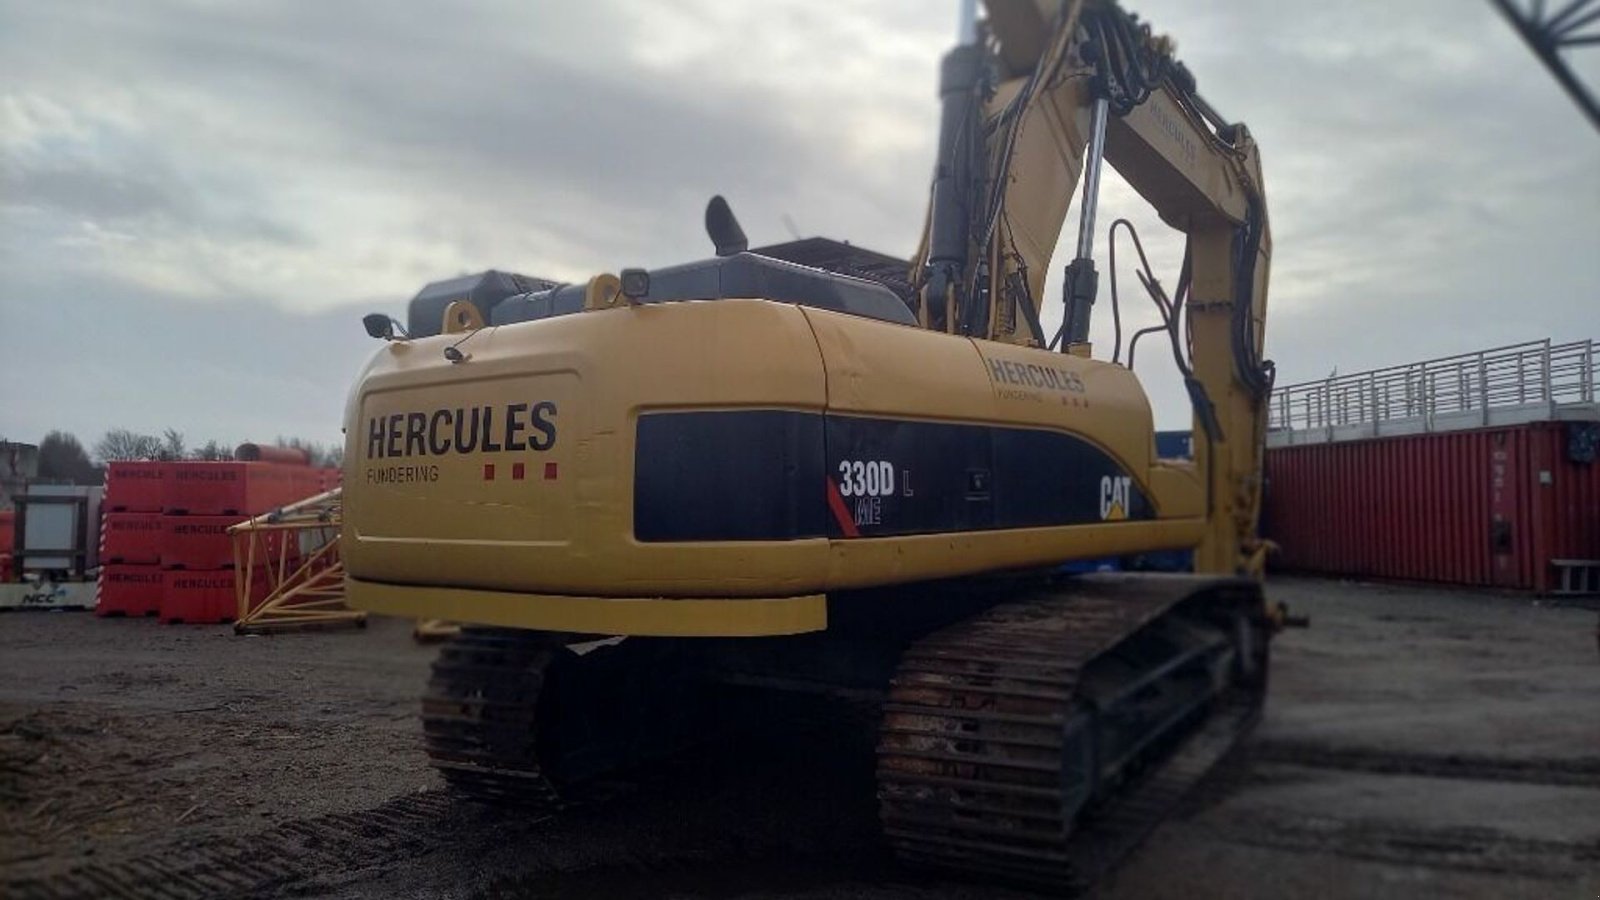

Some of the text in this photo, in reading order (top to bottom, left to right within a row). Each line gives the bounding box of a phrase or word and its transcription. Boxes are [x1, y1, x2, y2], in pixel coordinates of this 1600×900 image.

[988, 357, 1085, 393] HERCULES
[367, 401, 557, 459] HERCULES
[114, 469, 164, 479] HERCULE
[175, 470, 237, 481] HERCULES
[367, 464, 439, 484] FUNDERING
[838, 460, 914, 497] 330D L
[1100, 475, 1131, 520] CAT
[174, 524, 228, 535] HERCULE
[174, 578, 234, 588] HERCULES
[23, 593, 56, 603] NCC
